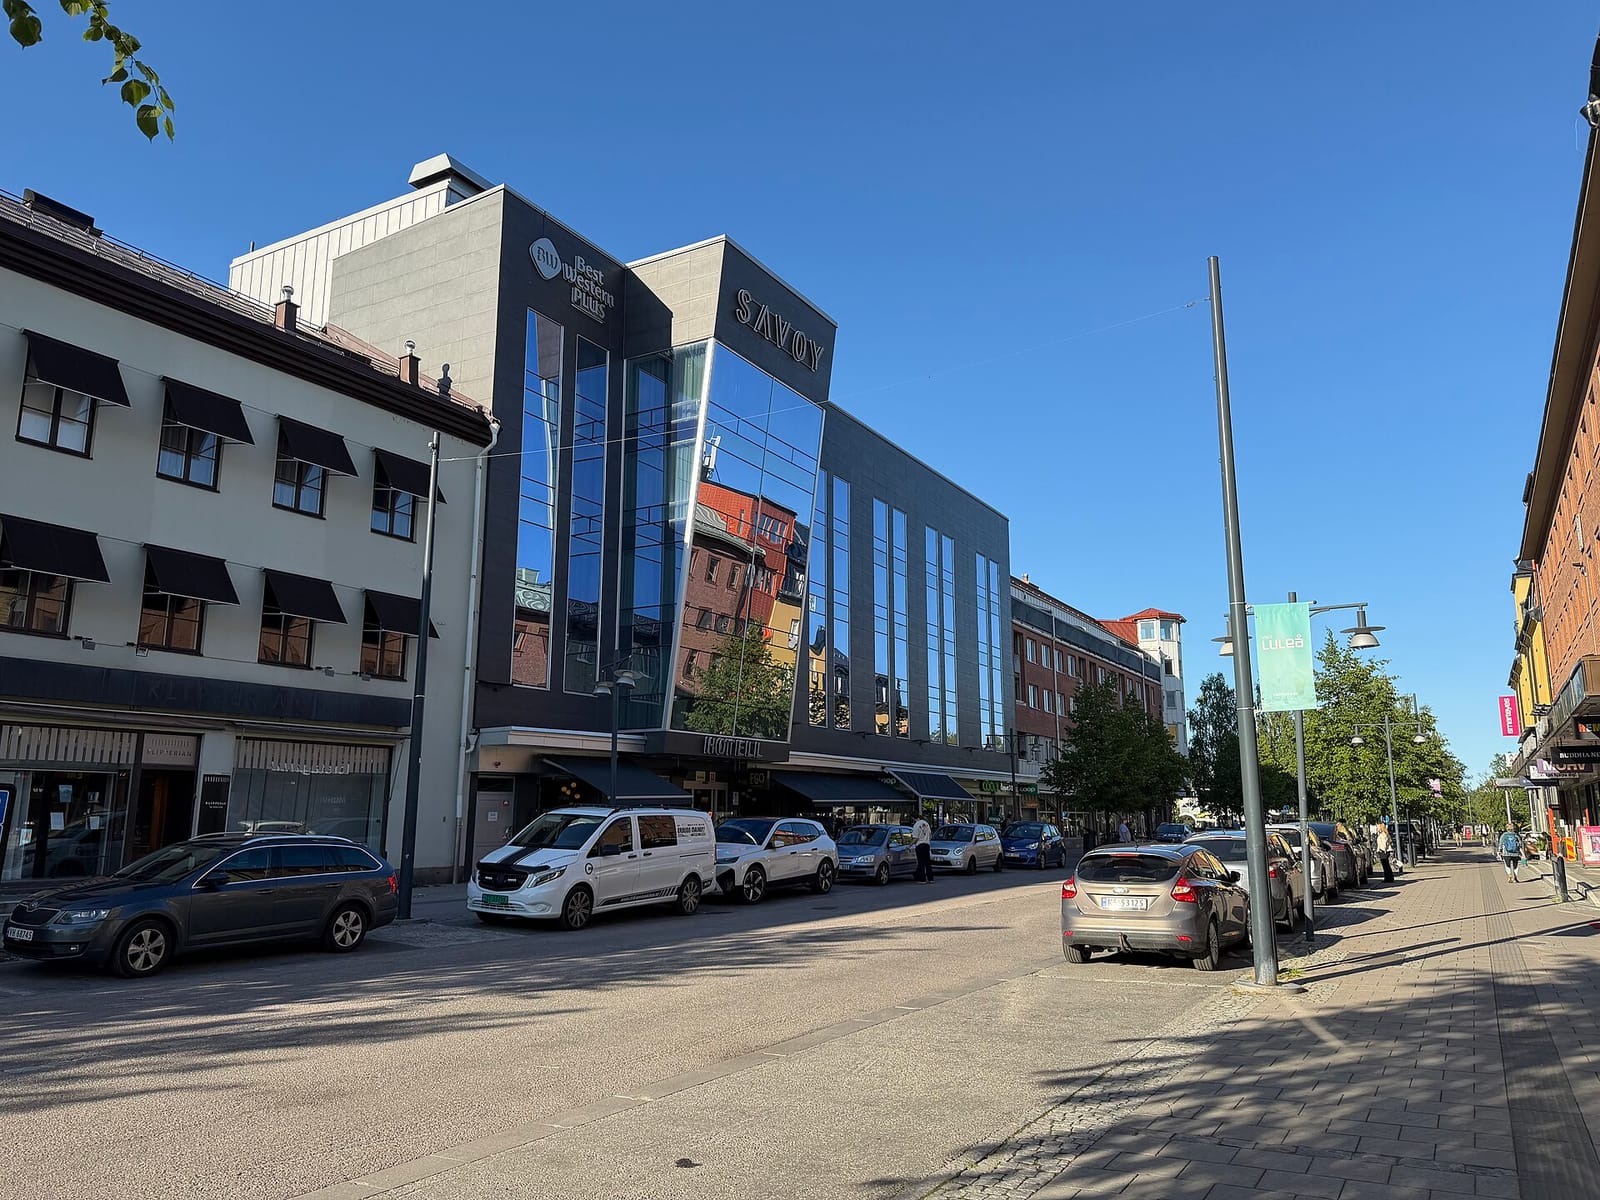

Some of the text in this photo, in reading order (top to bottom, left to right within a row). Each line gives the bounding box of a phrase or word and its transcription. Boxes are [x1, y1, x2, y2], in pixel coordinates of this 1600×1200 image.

[562, 262, 615, 308] Western
[574, 255, 605, 287] Best
[734, 288, 825, 373] SAVOY
[703, 735, 764, 758] HOTELL
